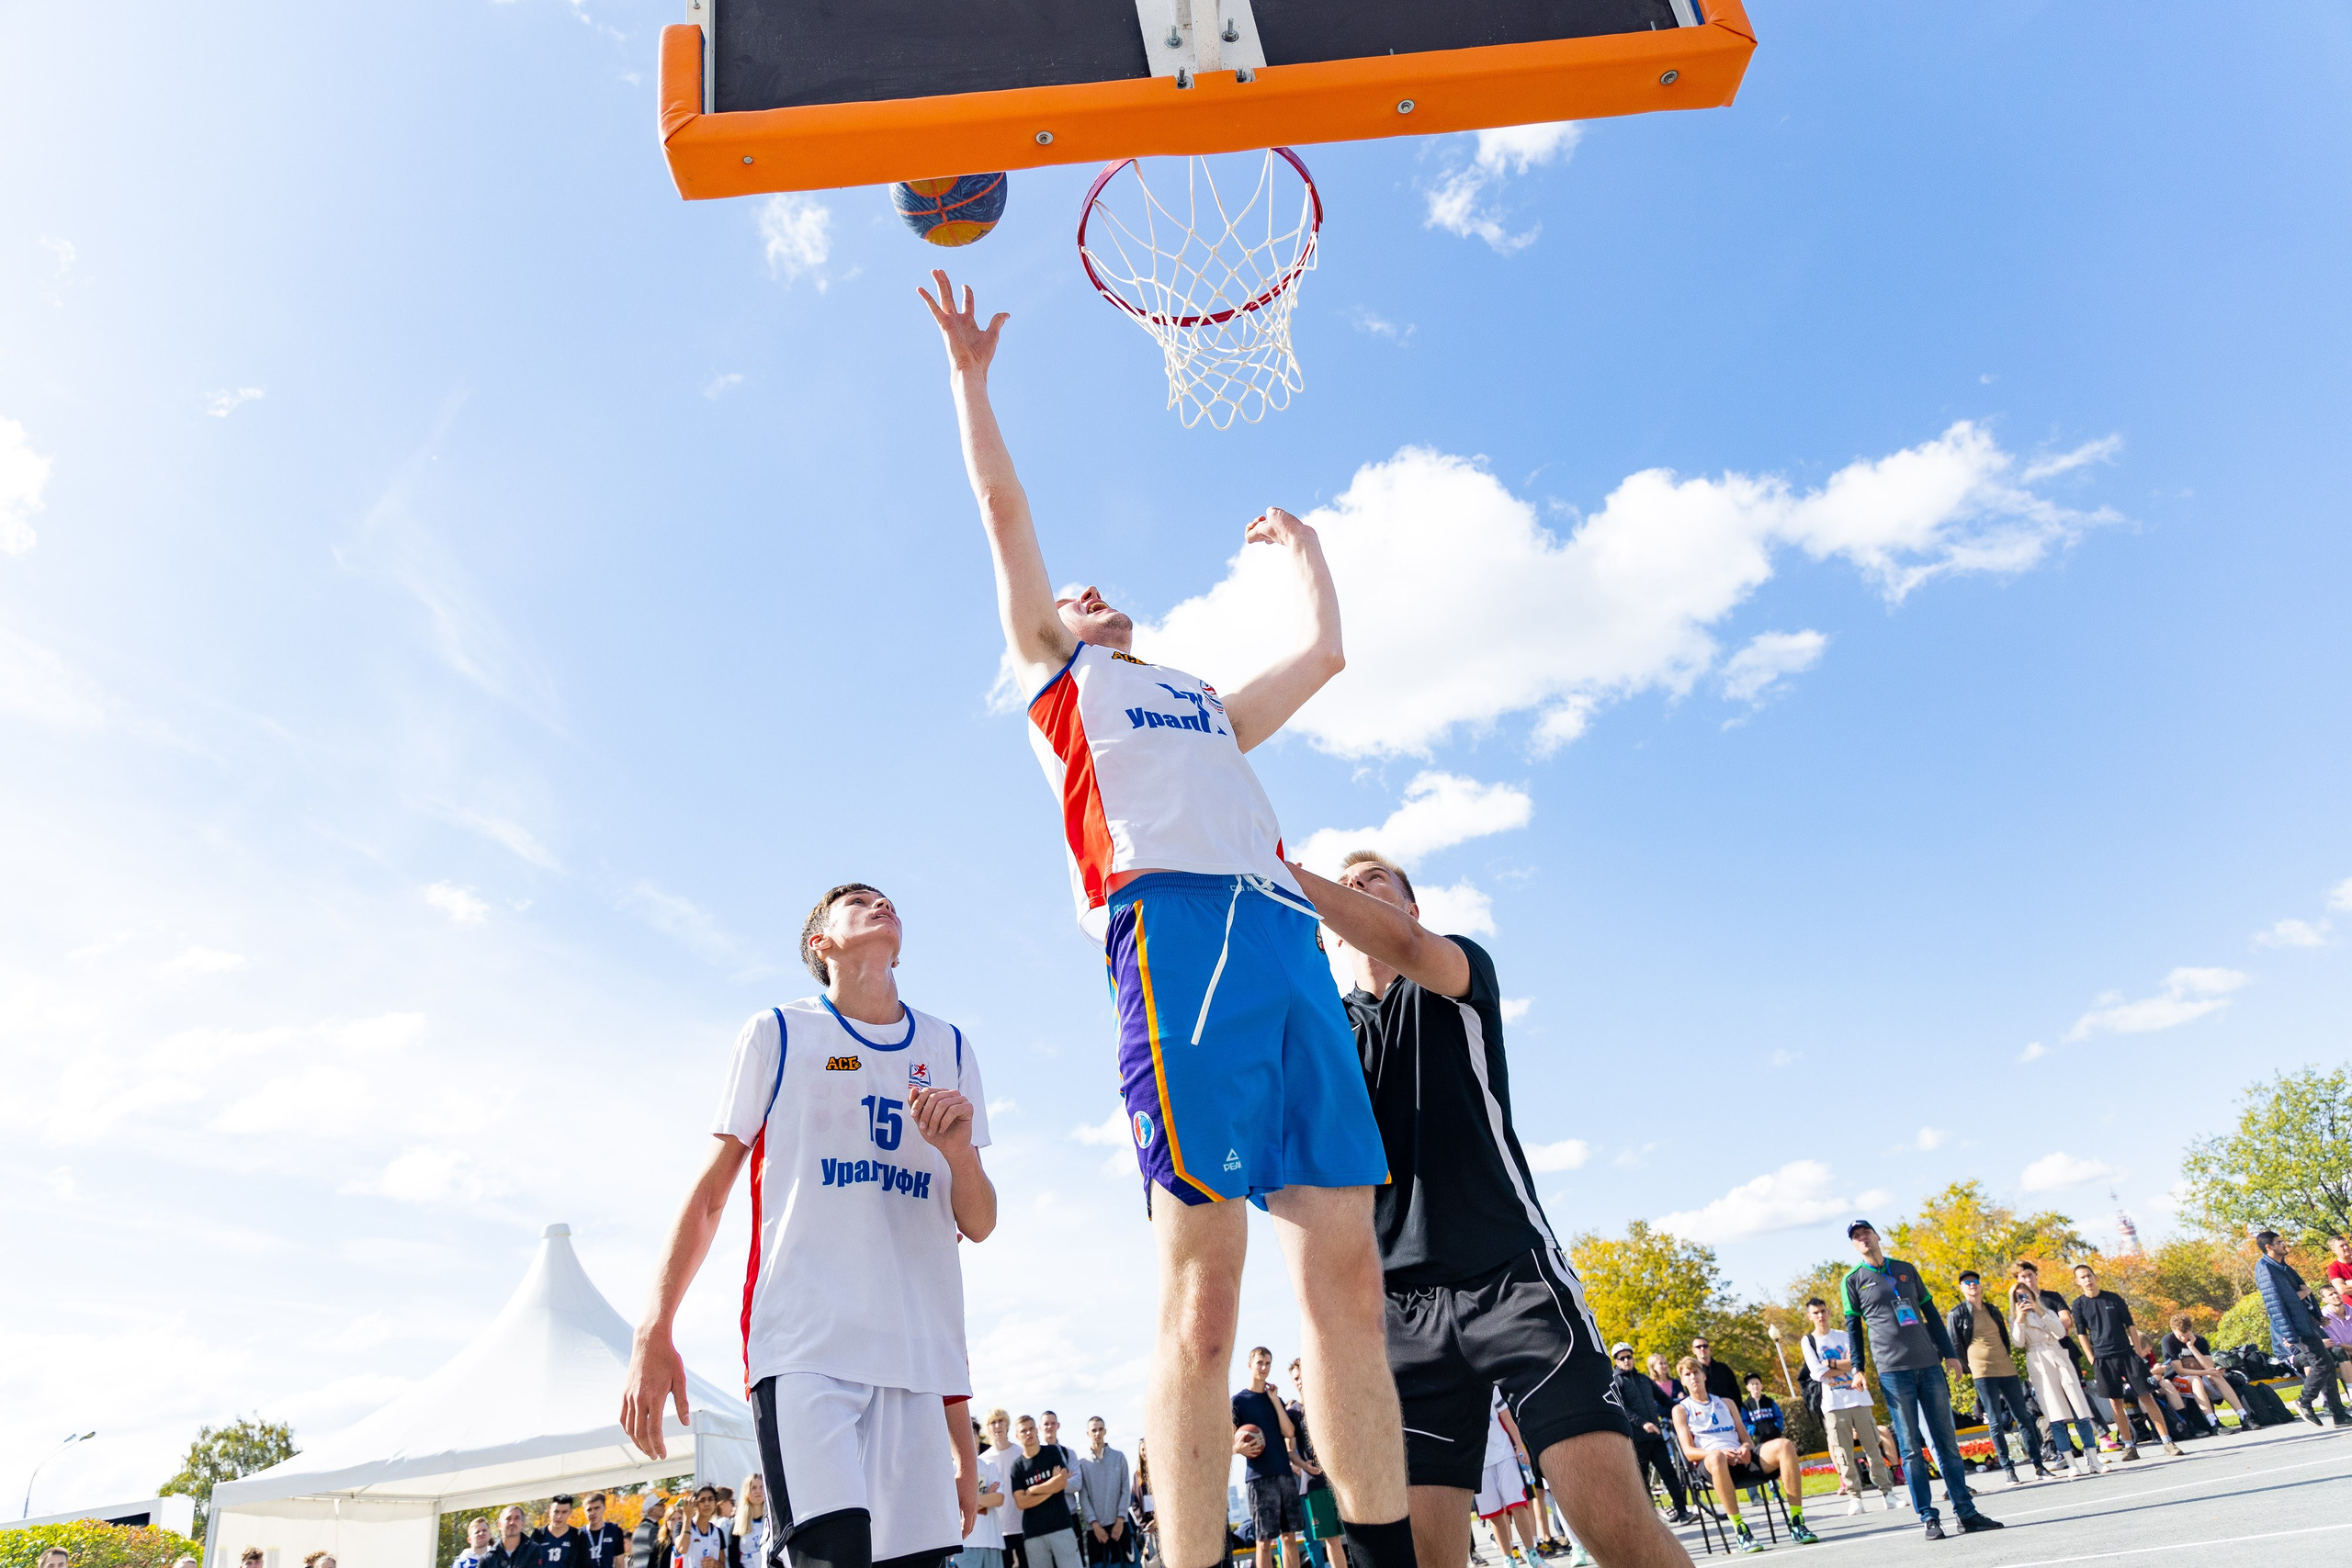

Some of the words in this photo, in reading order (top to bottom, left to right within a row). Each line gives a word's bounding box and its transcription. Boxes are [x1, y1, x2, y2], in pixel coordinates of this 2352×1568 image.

[861, 1095, 903, 1151] 15
[548, 1548, 561, 1562] 13
[589, 1546, 602, 1559] 12
